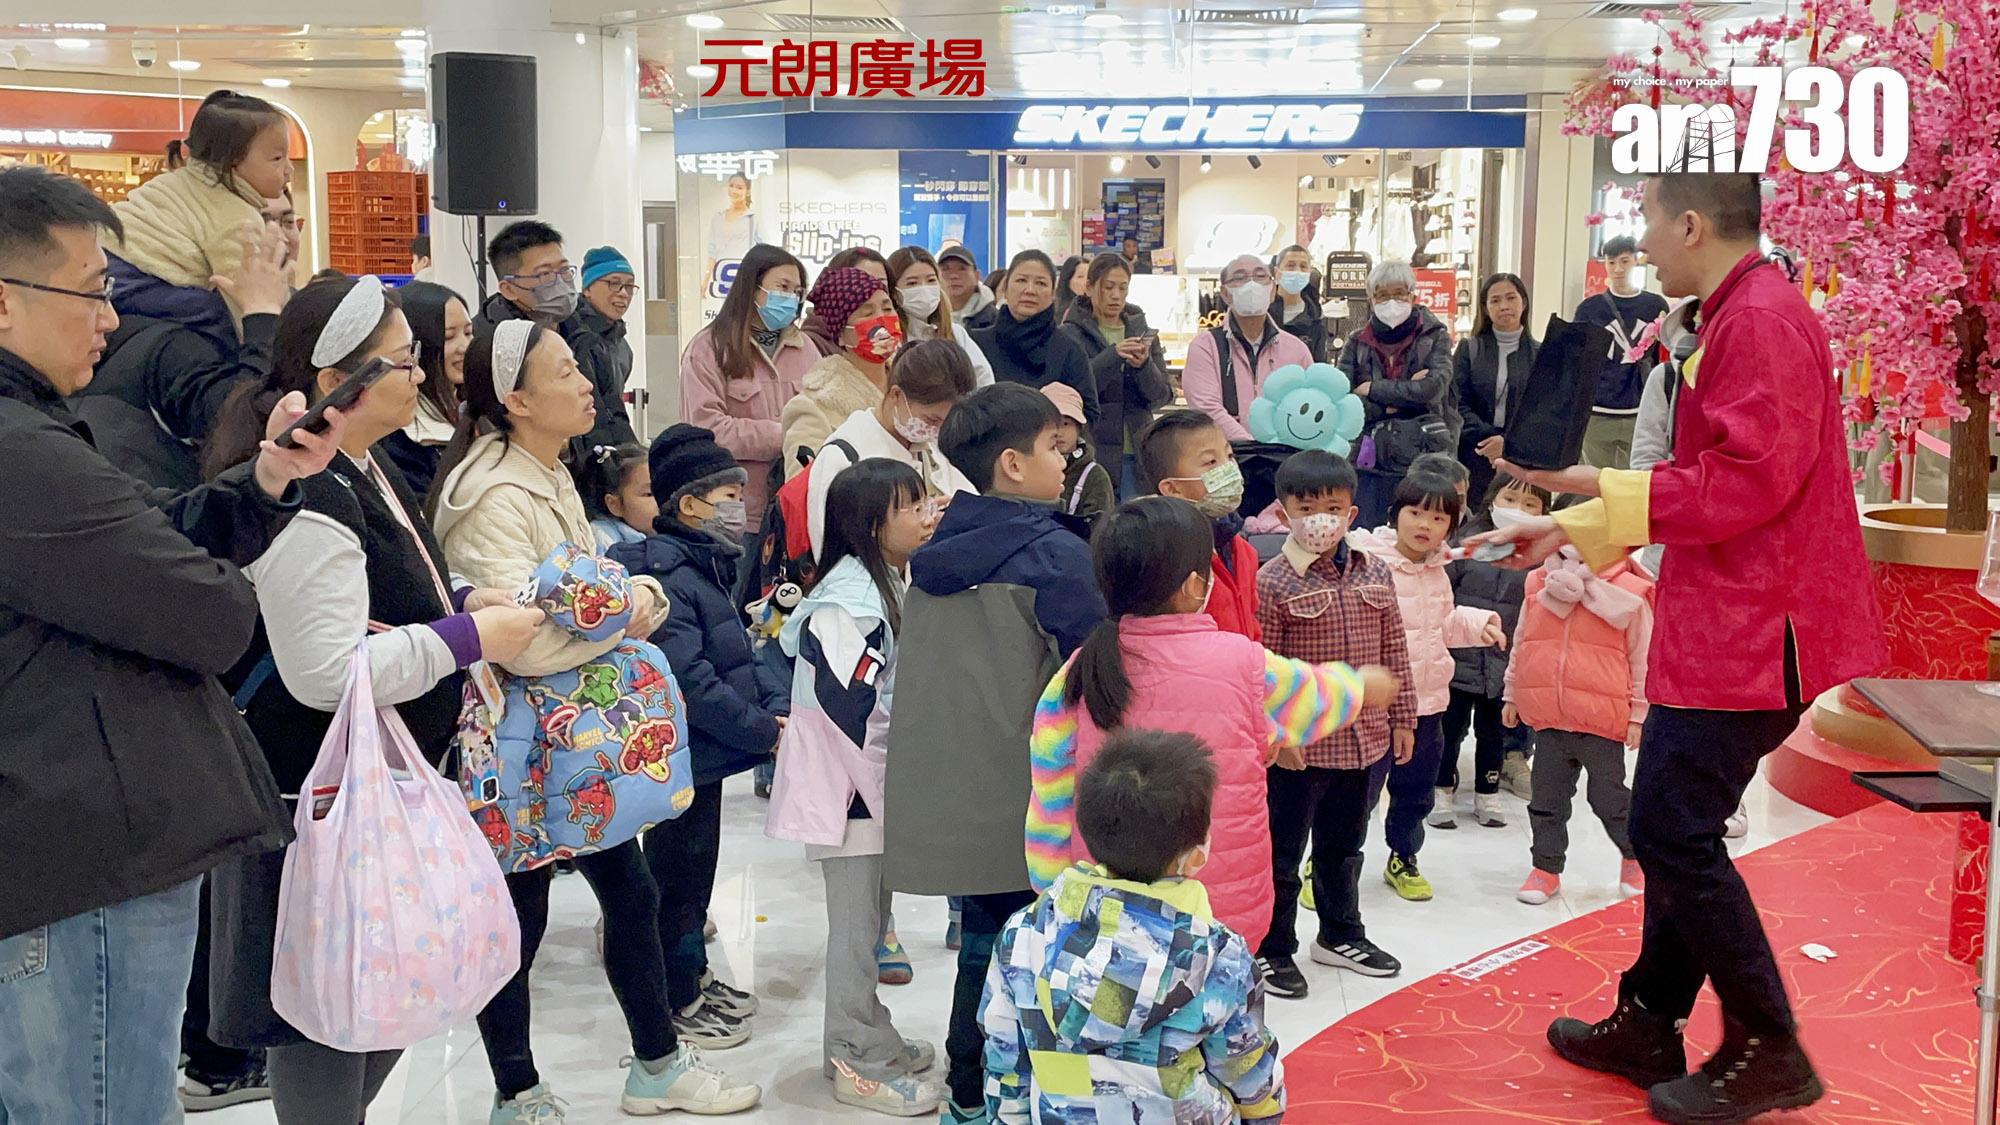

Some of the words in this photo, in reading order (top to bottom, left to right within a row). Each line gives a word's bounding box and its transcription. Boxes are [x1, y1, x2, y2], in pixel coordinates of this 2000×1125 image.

[1013, 104, 1363, 143] SKECHERS
[779, 202, 888, 214] SKECHERS
[1332, 271, 1366, 281] WORK
